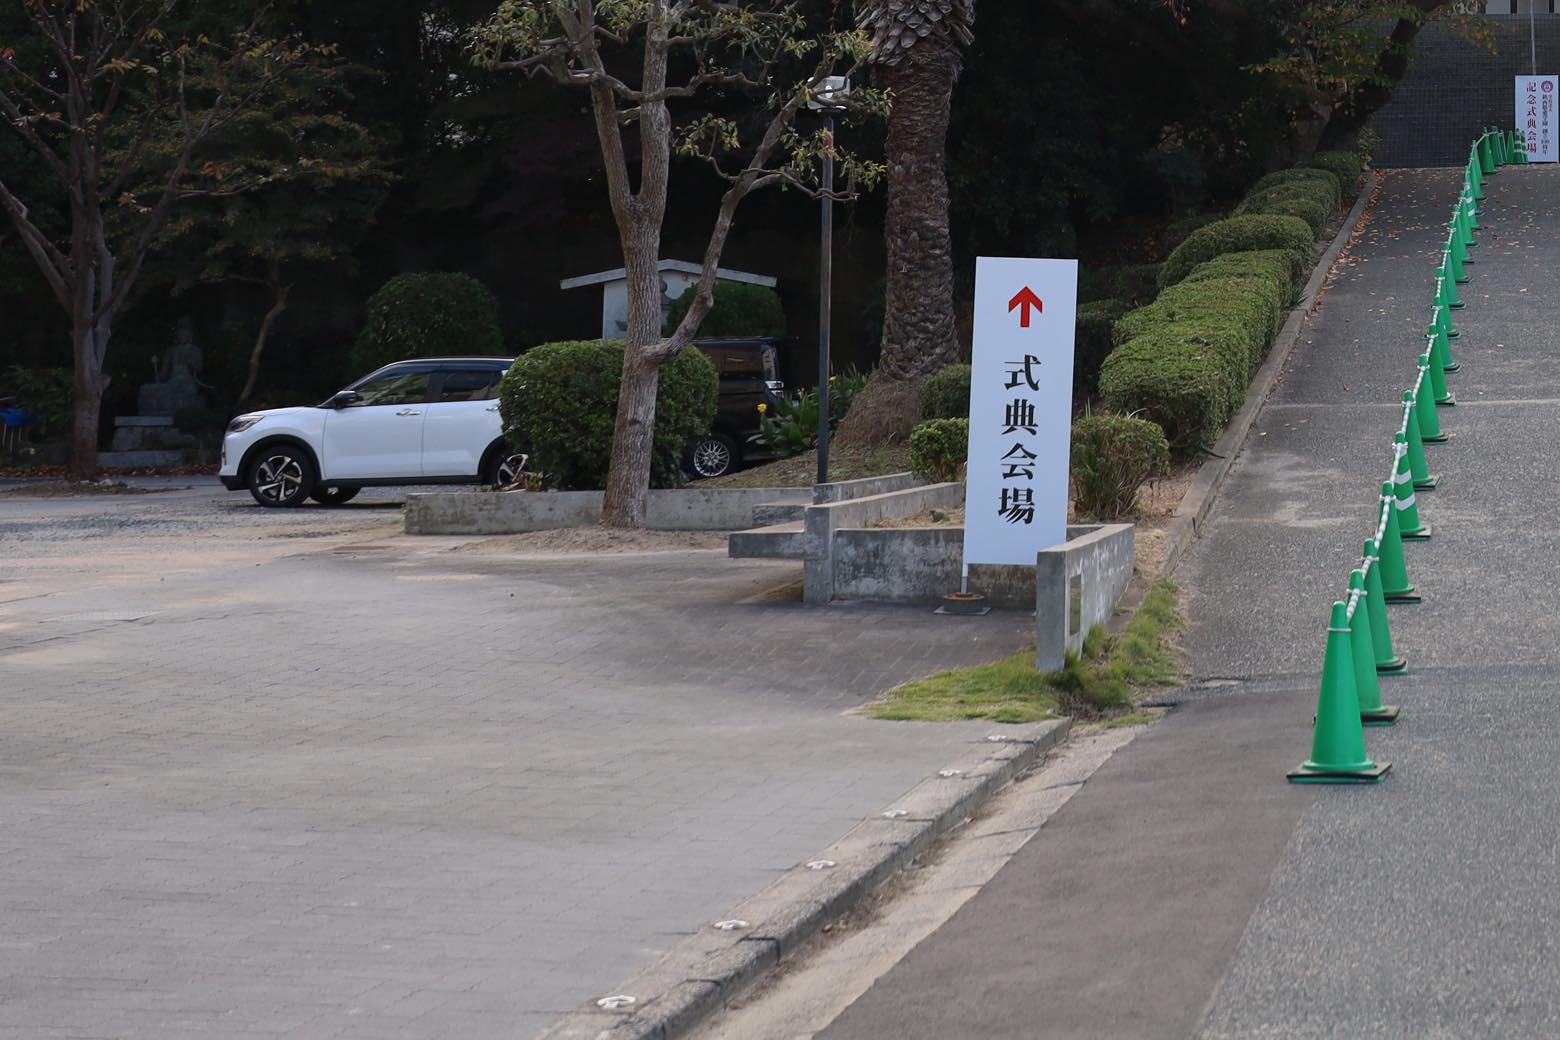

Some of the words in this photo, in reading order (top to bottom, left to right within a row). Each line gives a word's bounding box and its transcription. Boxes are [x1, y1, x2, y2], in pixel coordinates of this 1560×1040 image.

[1527, 82, 1537, 153] 記念式典会場
[998, 354, 1042, 525] 式典会場
